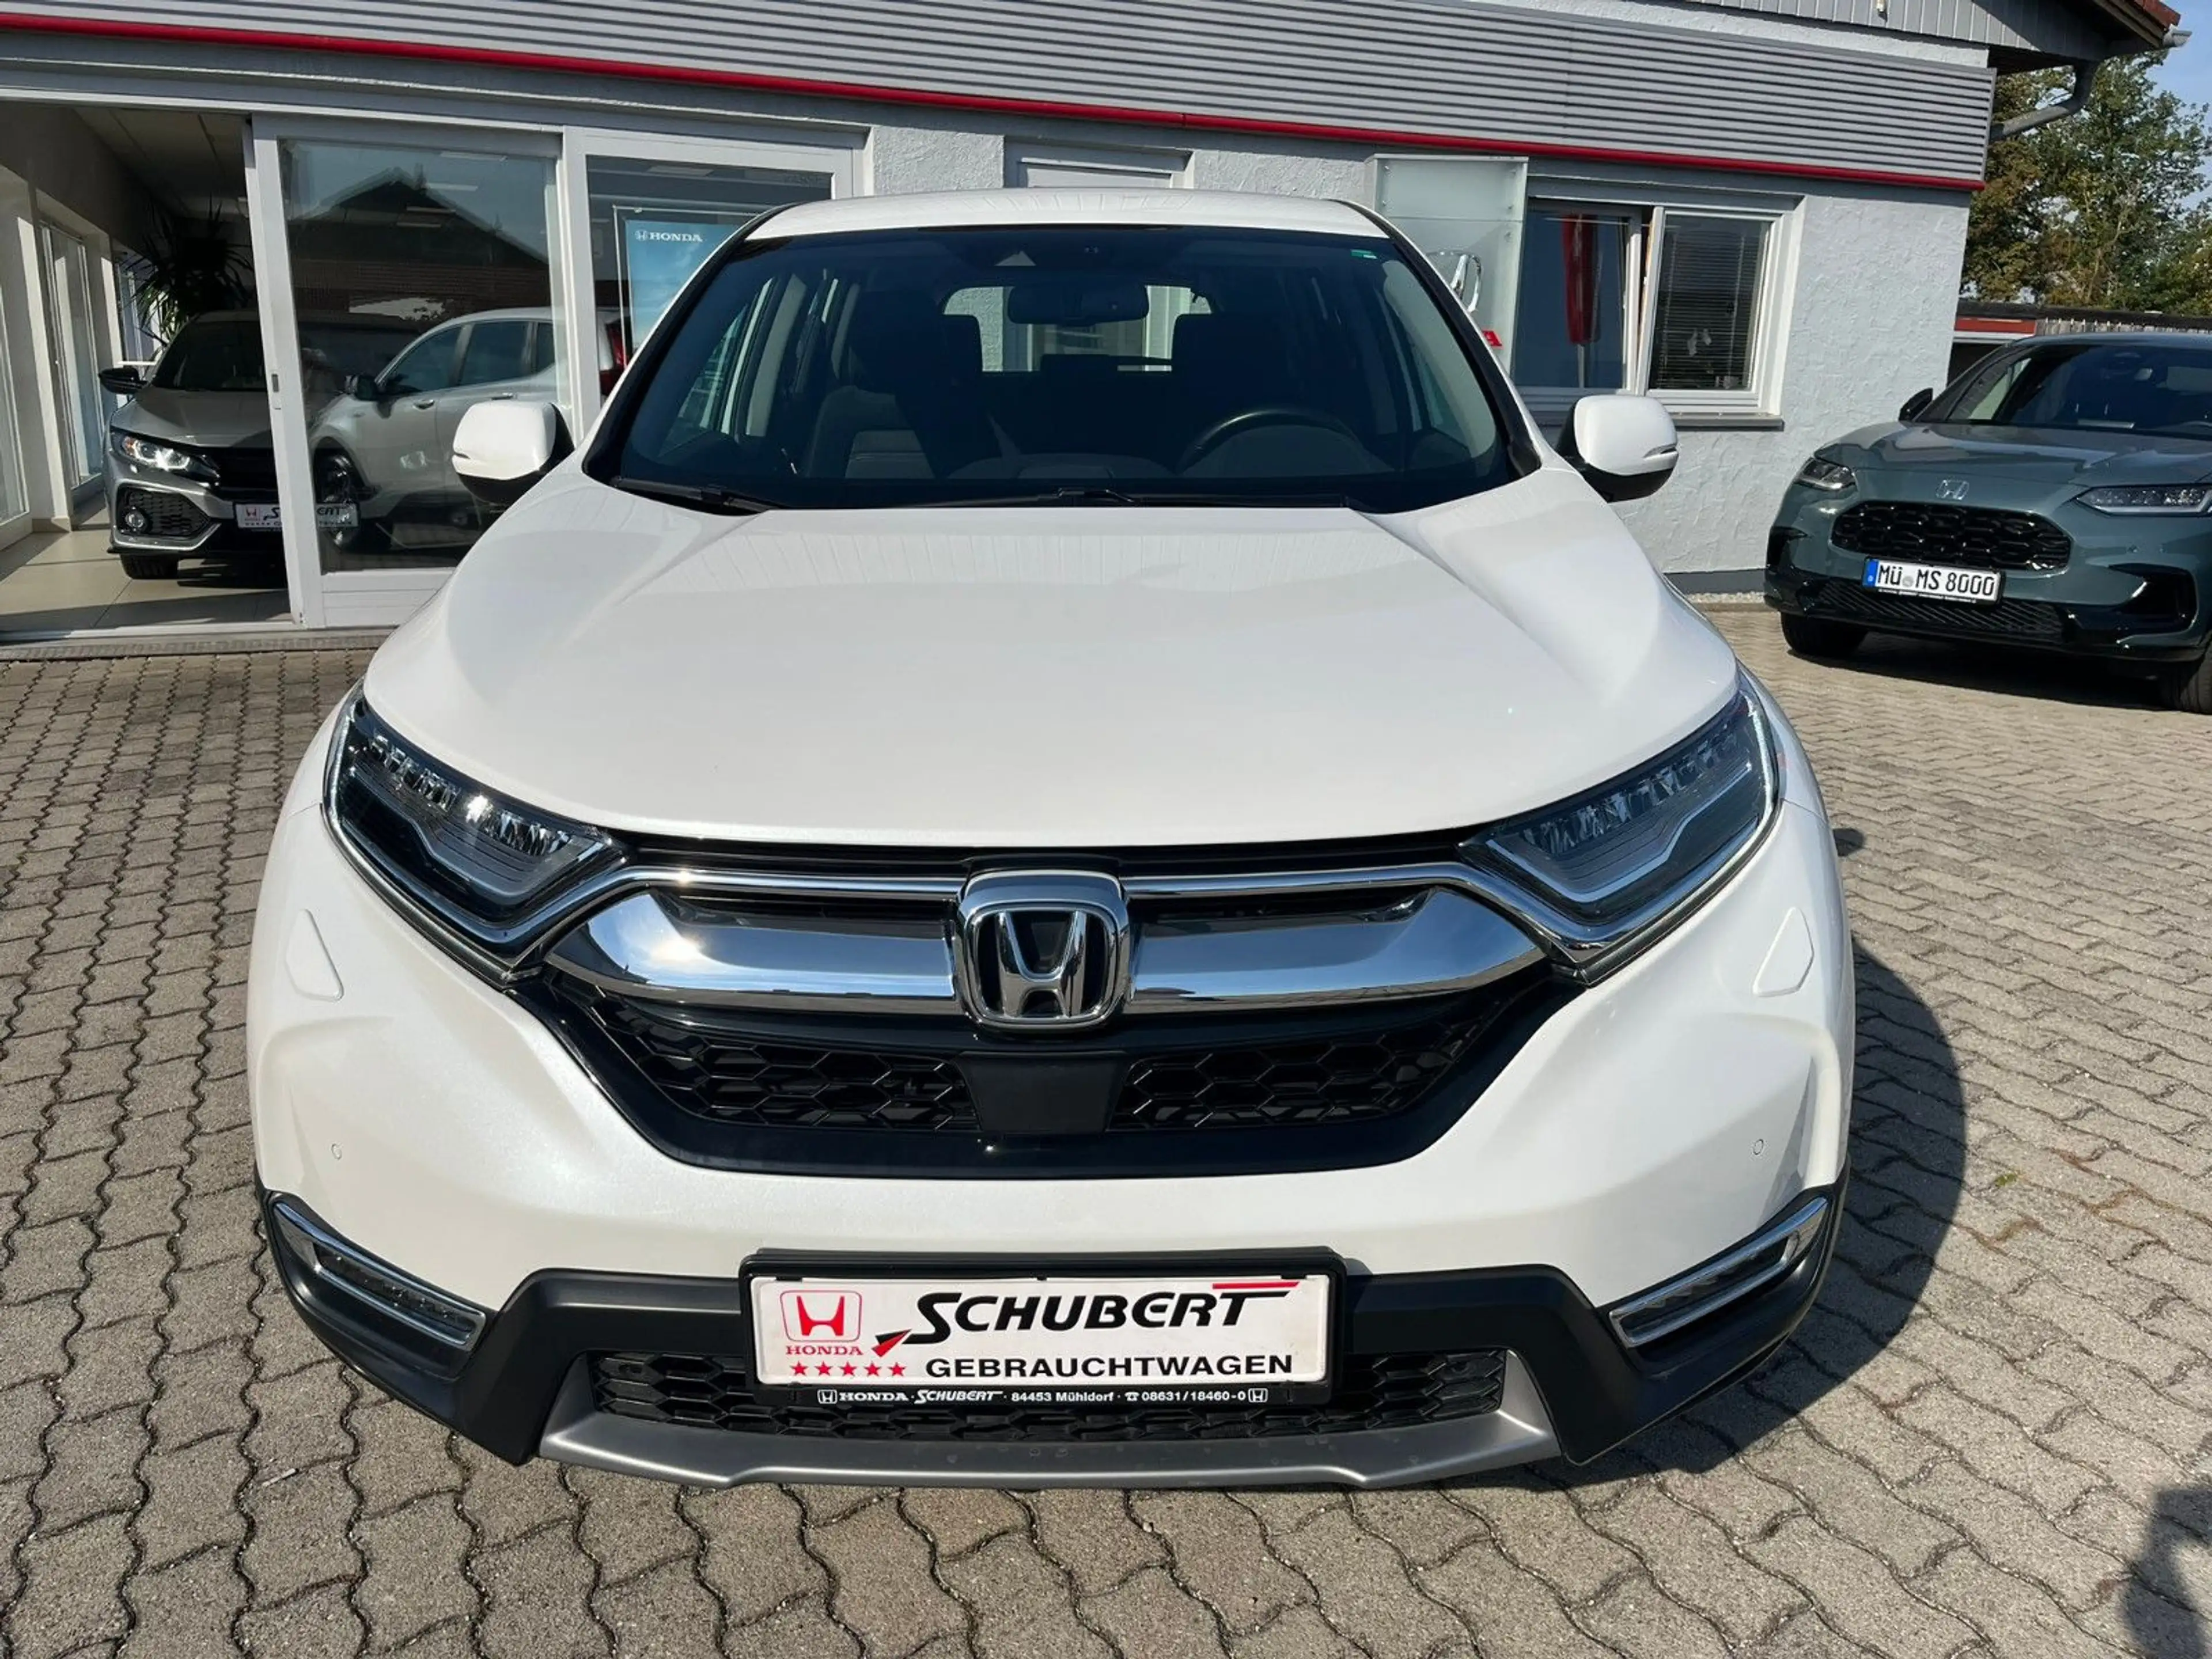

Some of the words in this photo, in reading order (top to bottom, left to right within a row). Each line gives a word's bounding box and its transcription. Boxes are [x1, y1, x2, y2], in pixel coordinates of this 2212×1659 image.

[649, 232, 703, 242] HONDA
[1878, 565, 1903, 585] MÜ
[1915, 569, 1941, 590] MS
[1946, 573, 1994, 596] 8000
[902, 1290, 1291, 1344] SCHUBERT
[786, 1346, 863, 1355] HONDA
[925, 1355, 1292, 1377] GEBRAUCHTWAGEN
[839, 1391, 908, 1402] HONDA
[914, 1390, 1003, 1404] SCHUBERT
[1011, 1392, 1051, 1402] 84453
[1056, 1391, 1113, 1402] Mühldorf
